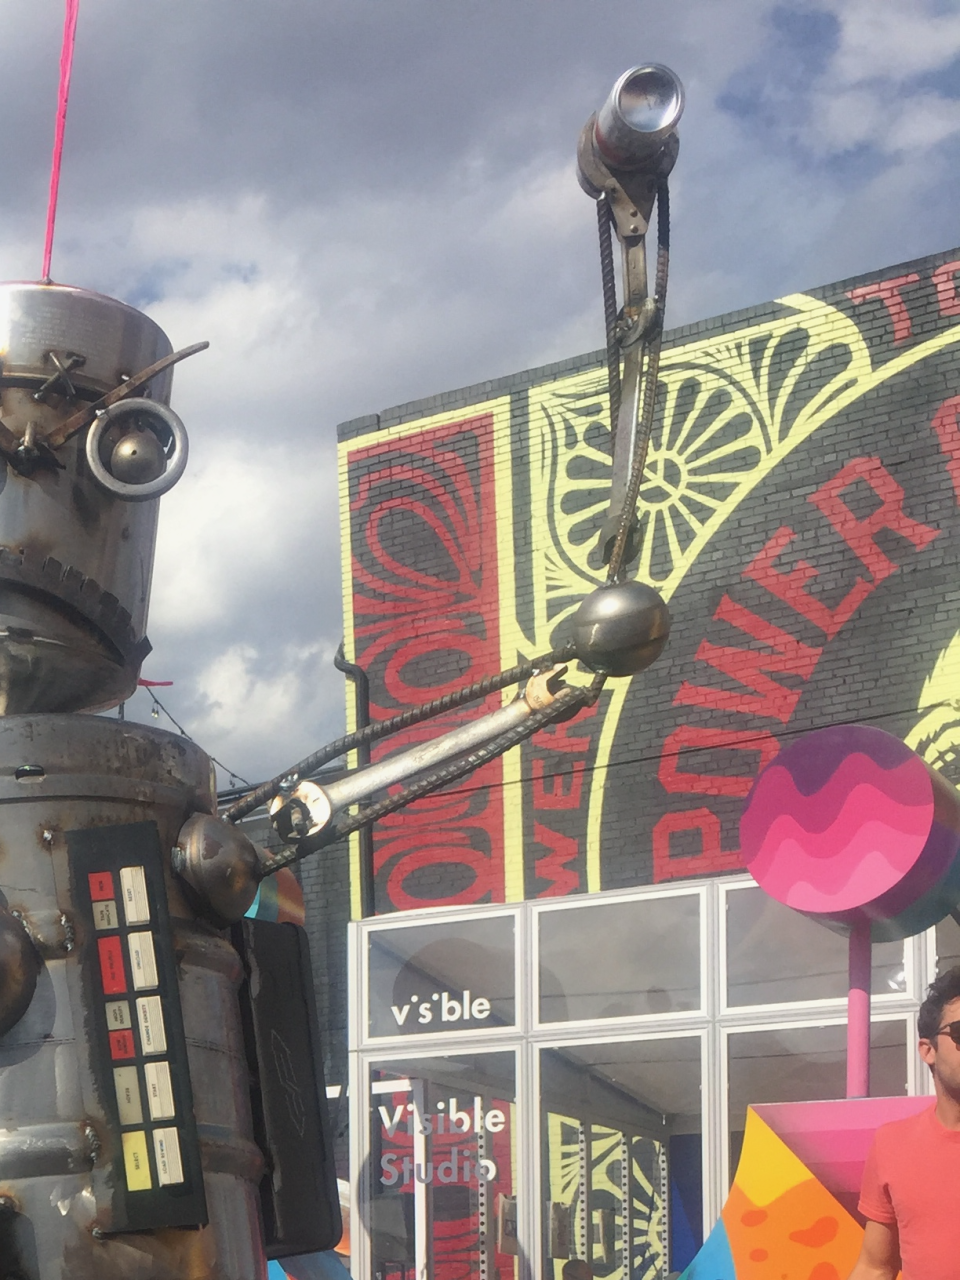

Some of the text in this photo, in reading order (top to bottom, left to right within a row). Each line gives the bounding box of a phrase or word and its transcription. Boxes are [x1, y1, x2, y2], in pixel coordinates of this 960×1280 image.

[652, 456, 942, 885] POWER
[378, 1096, 506, 1138] Visible
[132, 1152, 140, 1170] SELECT
[379, 1146, 497, 1186] Studio
